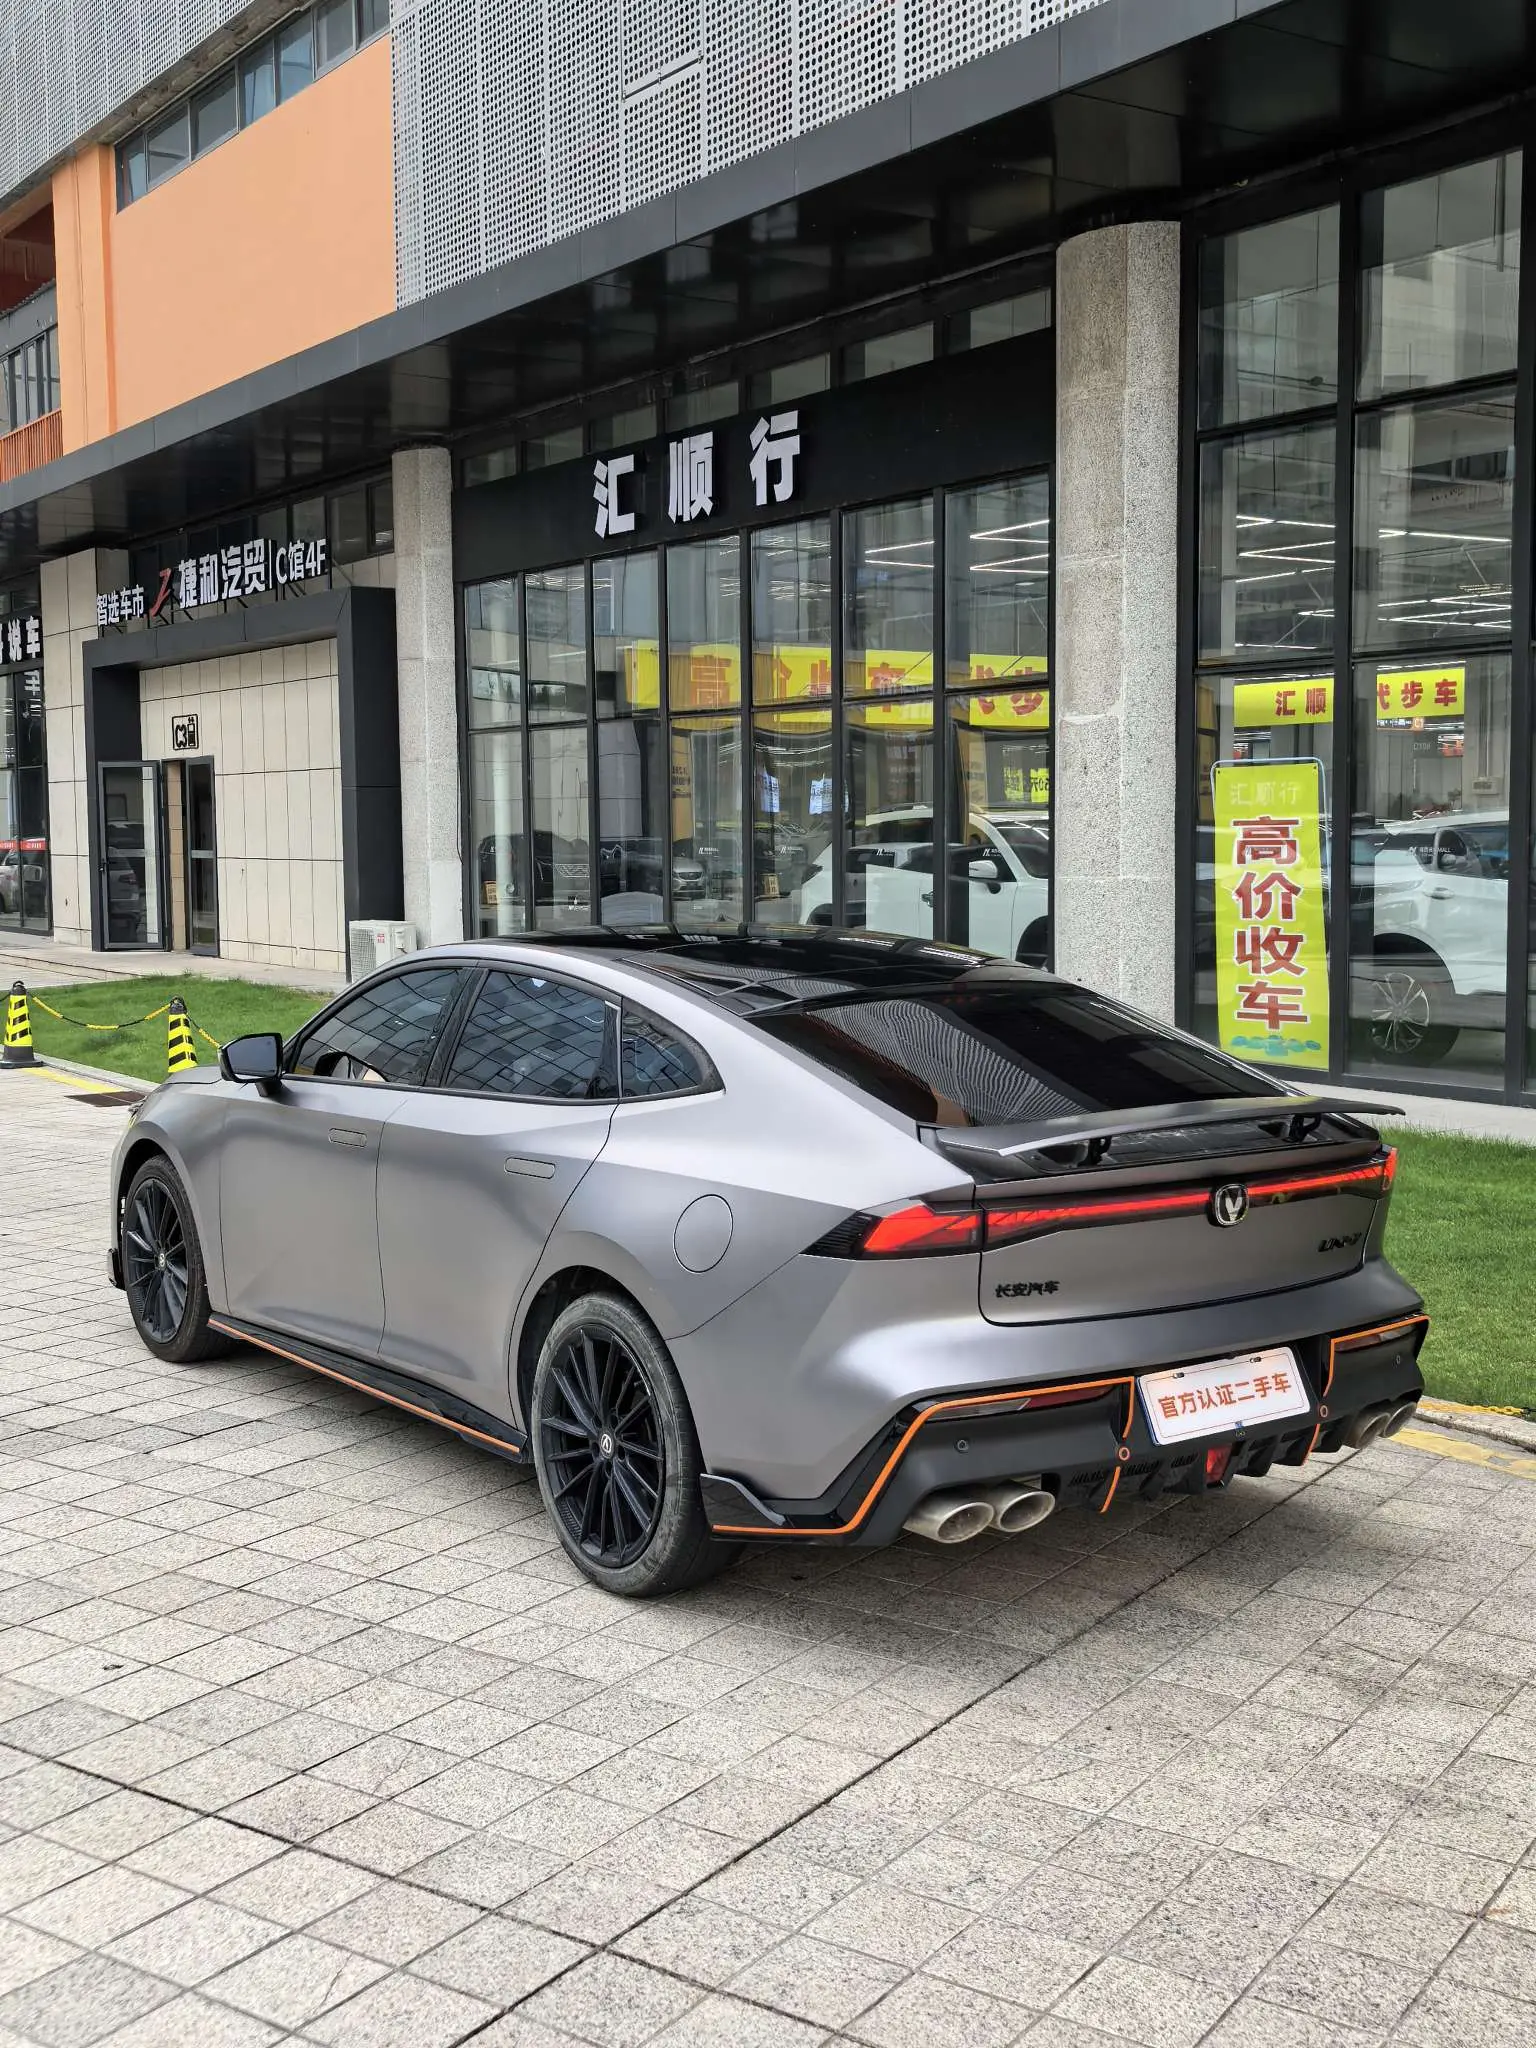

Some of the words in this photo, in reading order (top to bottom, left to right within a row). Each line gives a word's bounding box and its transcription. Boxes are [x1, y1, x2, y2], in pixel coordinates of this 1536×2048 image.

[593, 410, 801, 538] 汇顺行
[96, 583, 145, 626] 智选车市
[178, 538, 266, 609] 捷和汽贸
[275, 538, 327, 585] C馆4F
[691, 655, 906, 713] 高车
[1229, 782, 1300, 806] 汇顺行
[1232, 815, 1309, 1030] 高价收车
[995, 1280, 1061, 1299] 长安汽车
[1157, 1372, 1292, 1419] 官方认证二手车
